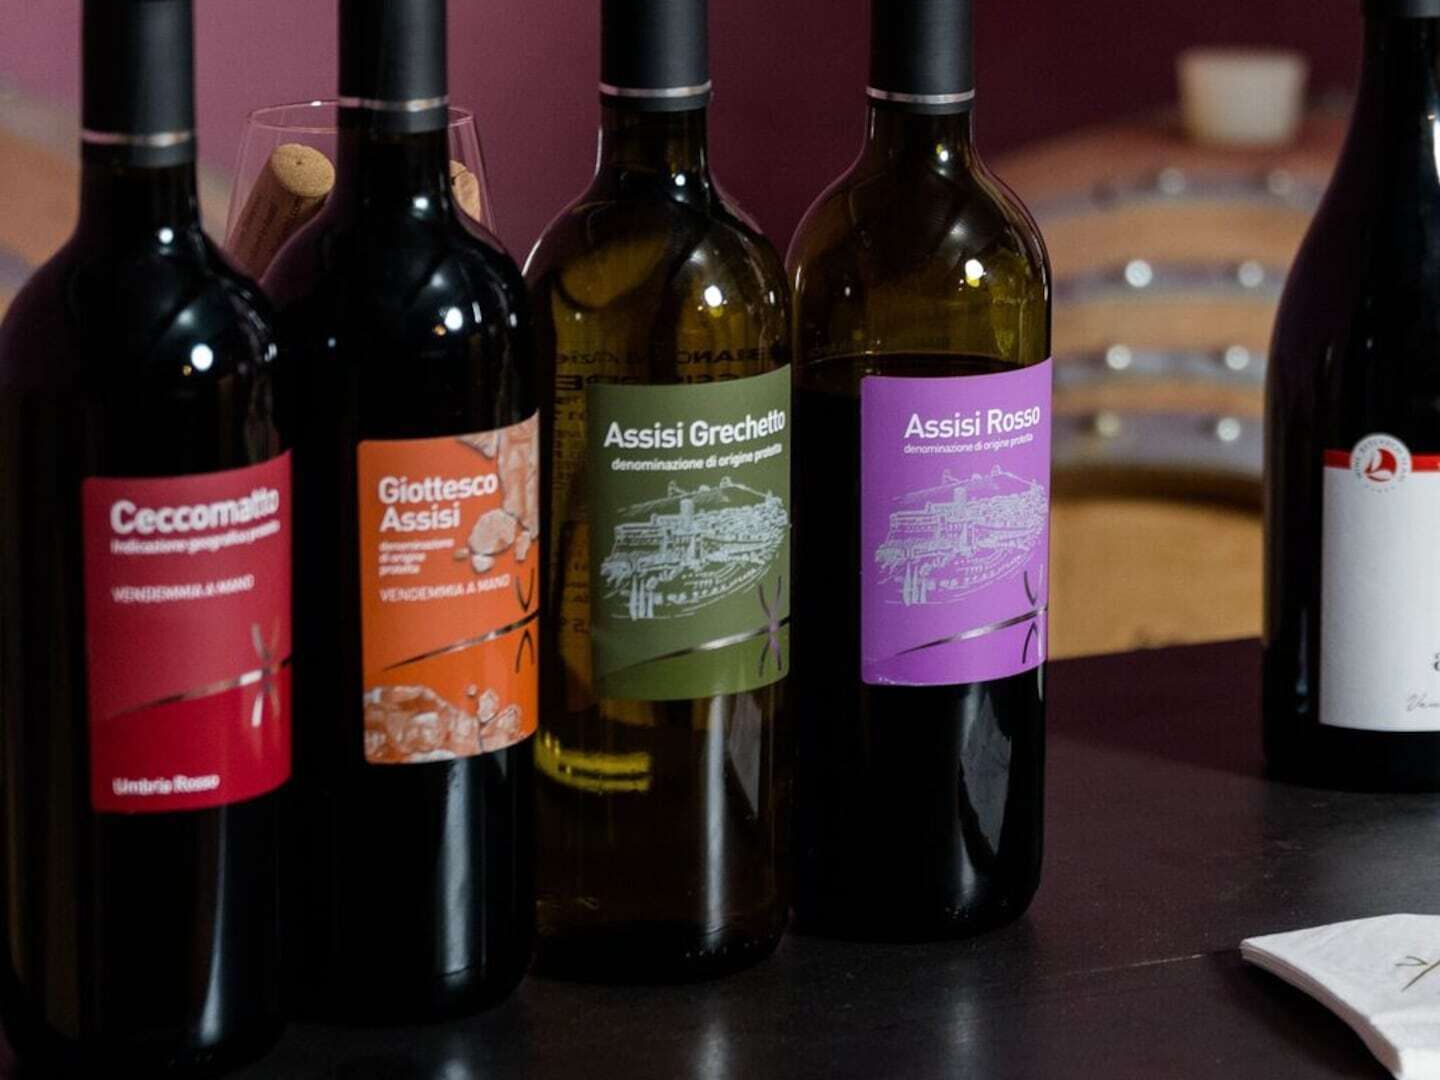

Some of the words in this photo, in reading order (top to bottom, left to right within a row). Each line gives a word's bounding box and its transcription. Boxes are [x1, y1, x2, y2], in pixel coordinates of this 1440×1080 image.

[603, 421, 684, 450] Assisi
[689, 408, 786, 448] Grechetto
[904, 410, 981, 439] Assisi
[987, 406, 1040, 435] Rosso
[611, 457, 704, 471] denominazione
[705, 455, 717, 469] di
[718, 450, 753, 469] origine
[903, 443, 973, 454] denominazione
[378, 473, 499, 504] Giottesco
[110, 487, 280, 535] Ceccomatto
[379, 501, 461, 533] Assisi
[379, 584, 464, 603] VENDEMMIA
[466, 580, 477, 595] A
